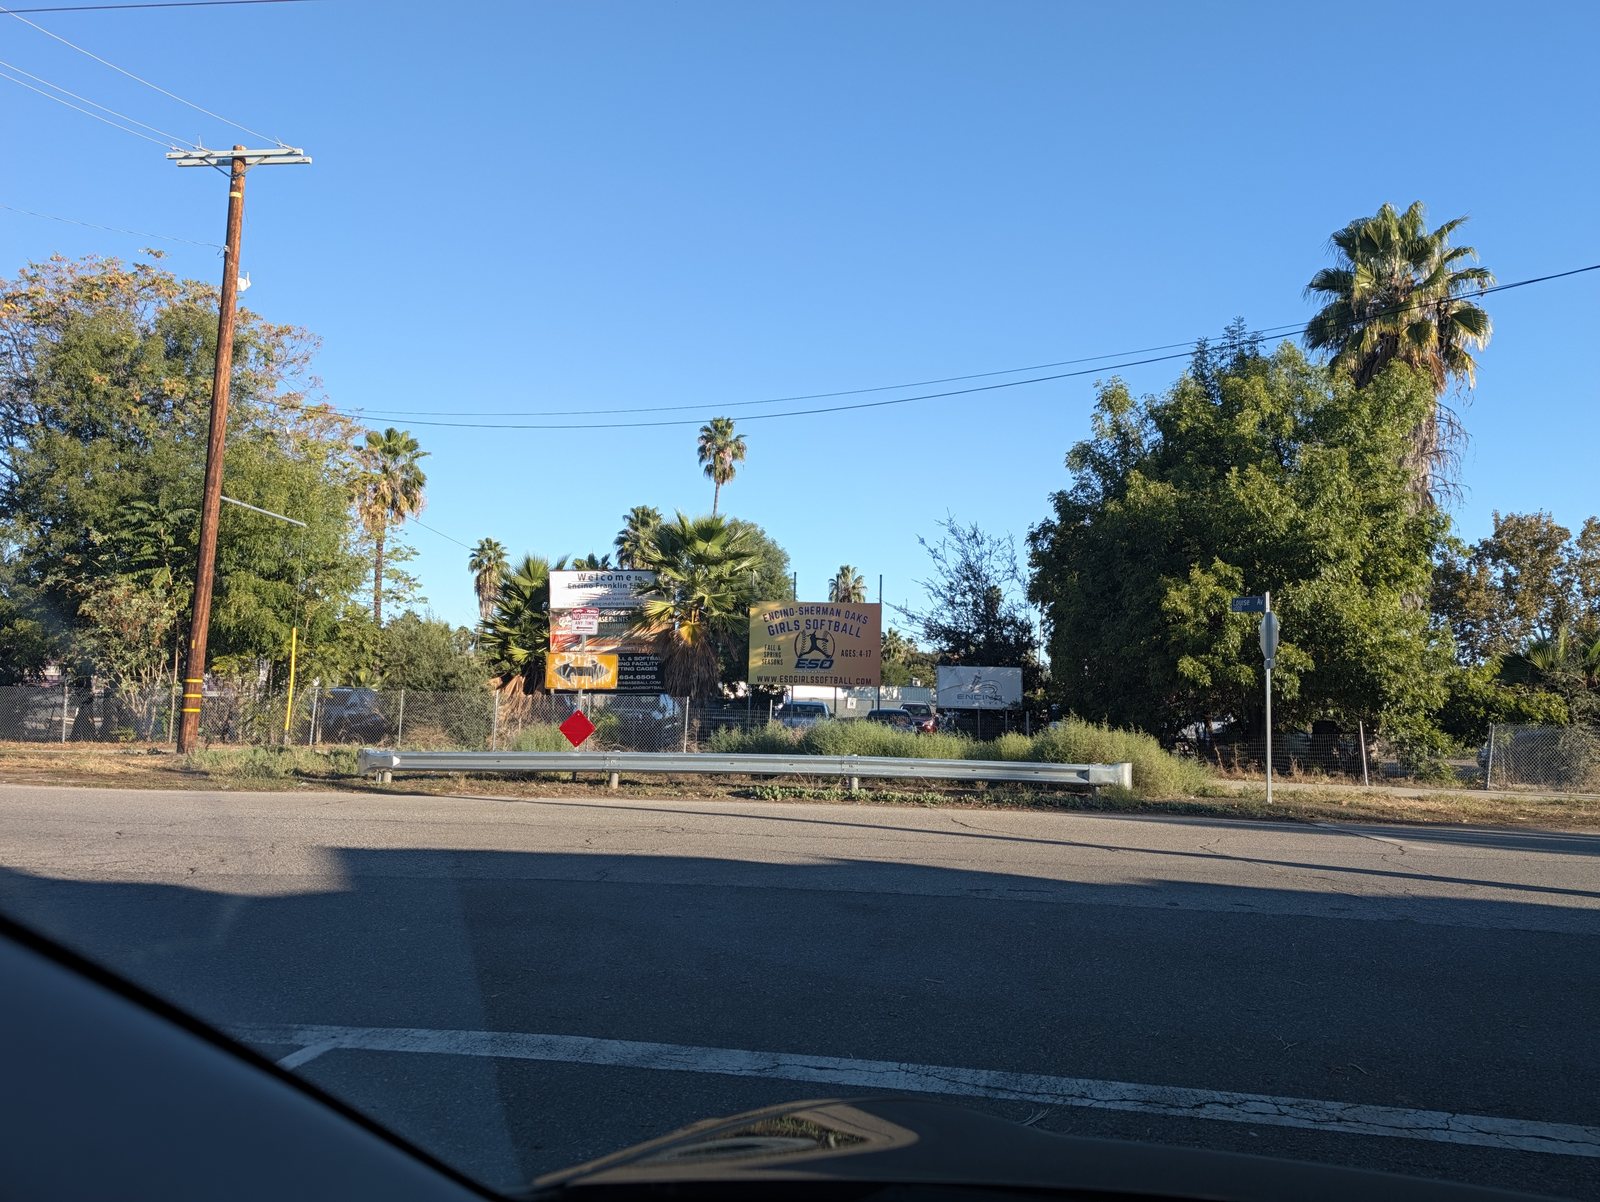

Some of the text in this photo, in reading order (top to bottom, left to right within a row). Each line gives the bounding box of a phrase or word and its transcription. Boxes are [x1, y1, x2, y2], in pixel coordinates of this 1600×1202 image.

[577, 573, 632, 581] Welcome
[763, 606, 869, 625] ENCINO-SHERMAN OAKS
[768, 619, 861, 638] GIRLS SOFTBALL
[840, 650, 872, 658] AGES: 4-17
[794, 658, 834, 669] ESO
[756, 675, 872, 685] WWW.ESOGIRLSSOFTBALL.COM
